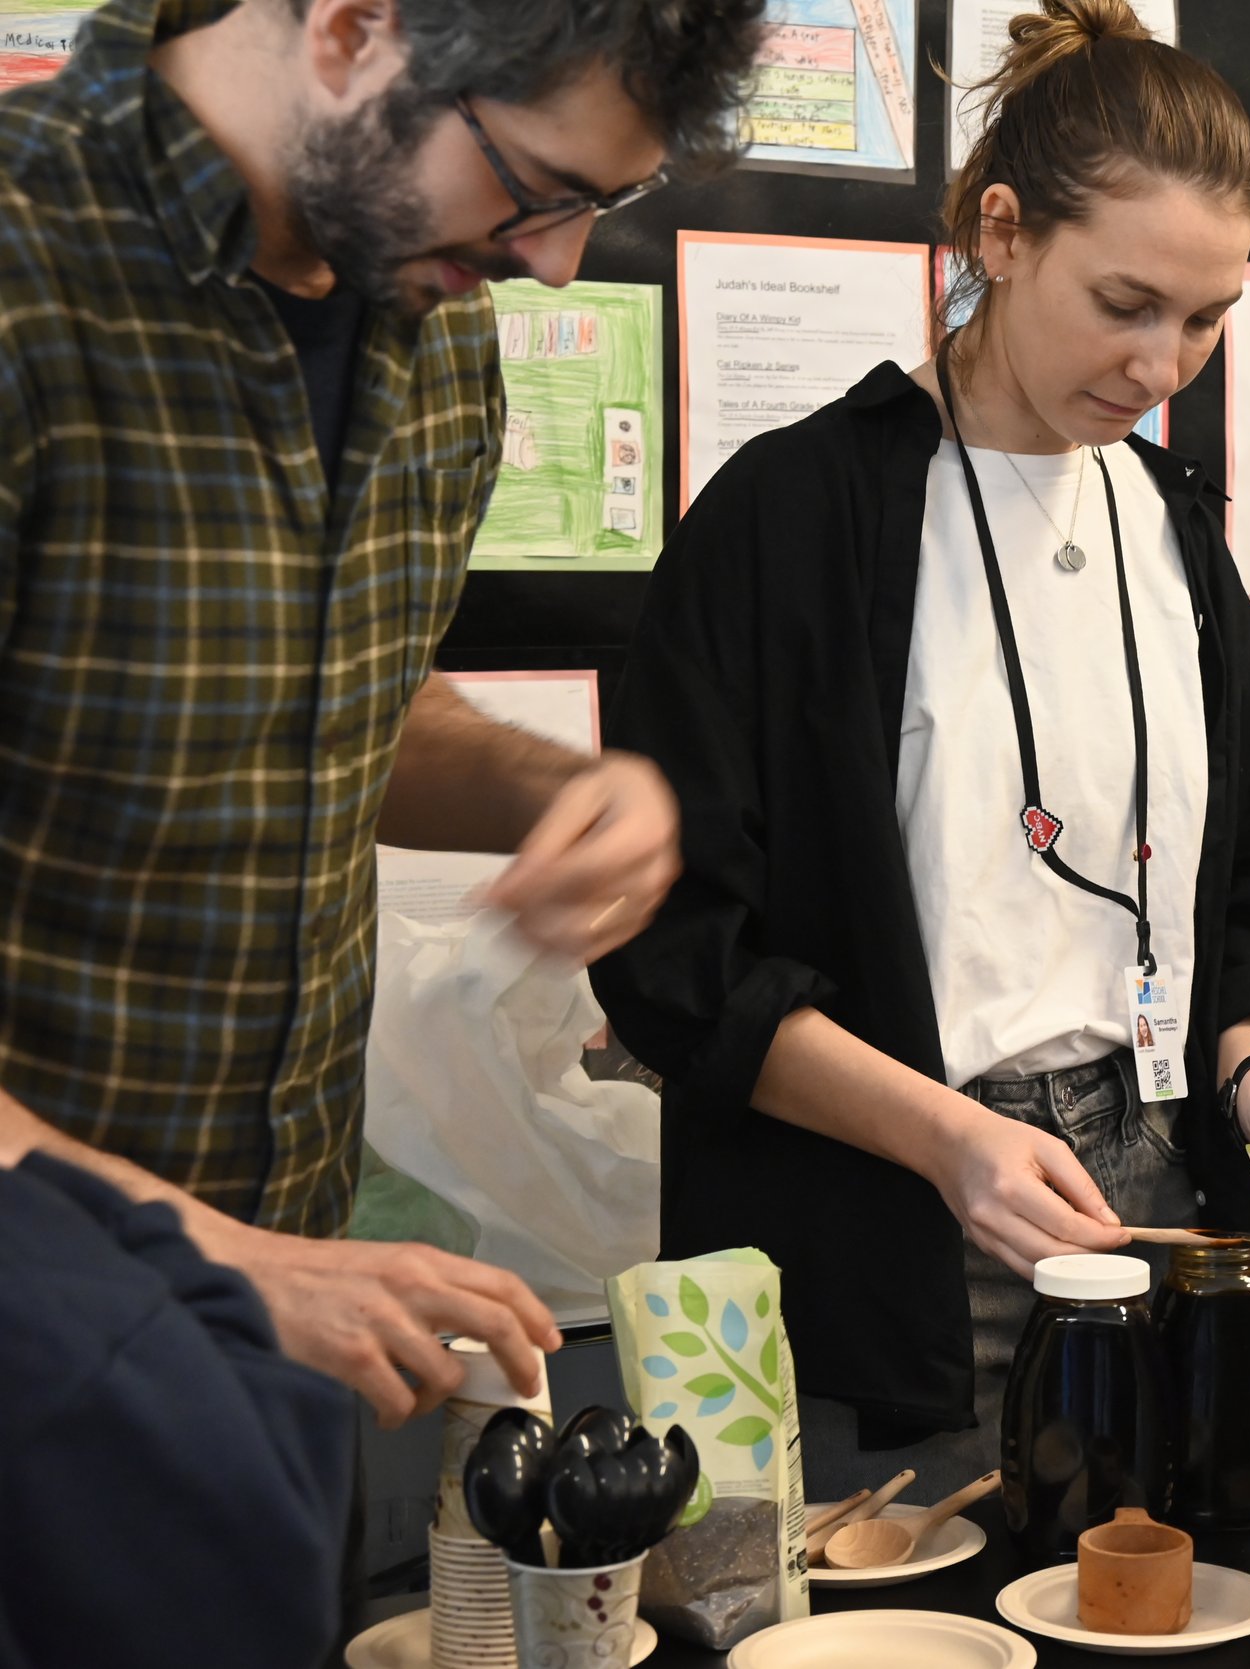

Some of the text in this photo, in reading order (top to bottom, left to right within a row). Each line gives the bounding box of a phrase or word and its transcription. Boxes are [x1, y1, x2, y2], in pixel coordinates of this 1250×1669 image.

[715, 279, 840, 295] Judah's Ideal Bookshelf
[716, 312, 801, 325] Diary Of A Wimpy Kid
[717, 360, 800, 371] Cal Ripken Jr Series
[717, 400, 739, 408] Tales
[741, 400, 750, 408] of
[760, 400, 788, 409] Fourth
[789, 401, 814, 410] Grade
[717, 439, 734, 449] And
[1153, 1017, 1178, 1027] Samantha
